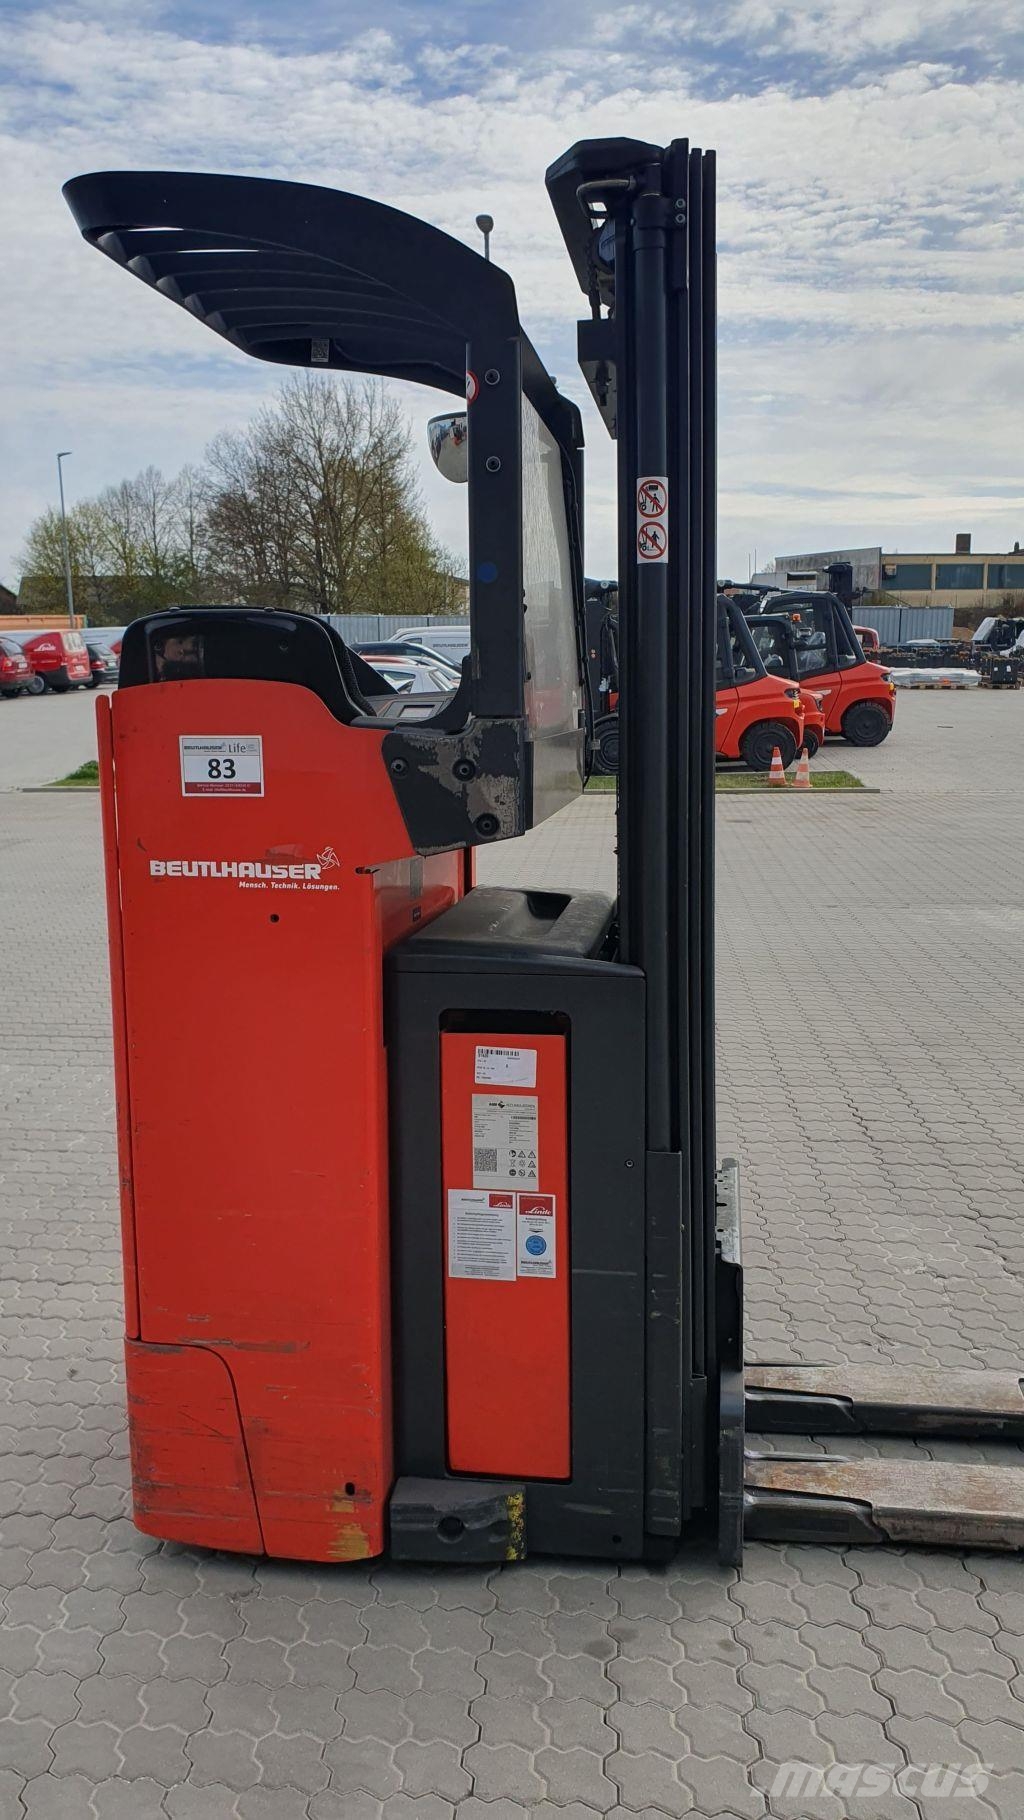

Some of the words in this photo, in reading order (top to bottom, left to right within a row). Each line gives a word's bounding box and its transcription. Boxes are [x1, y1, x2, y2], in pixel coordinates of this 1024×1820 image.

[228, 743, 247, 753] Life
[208, 758, 236, 779] 83
[150, 860, 321, 880] BEUTLHAUSER
[239, 881, 268, 889] Mensch.
[271, 881, 300, 889] Technik.
[302, 882, 340, 892] Lösungen.
[525, 1206, 551, 1215] Linde
